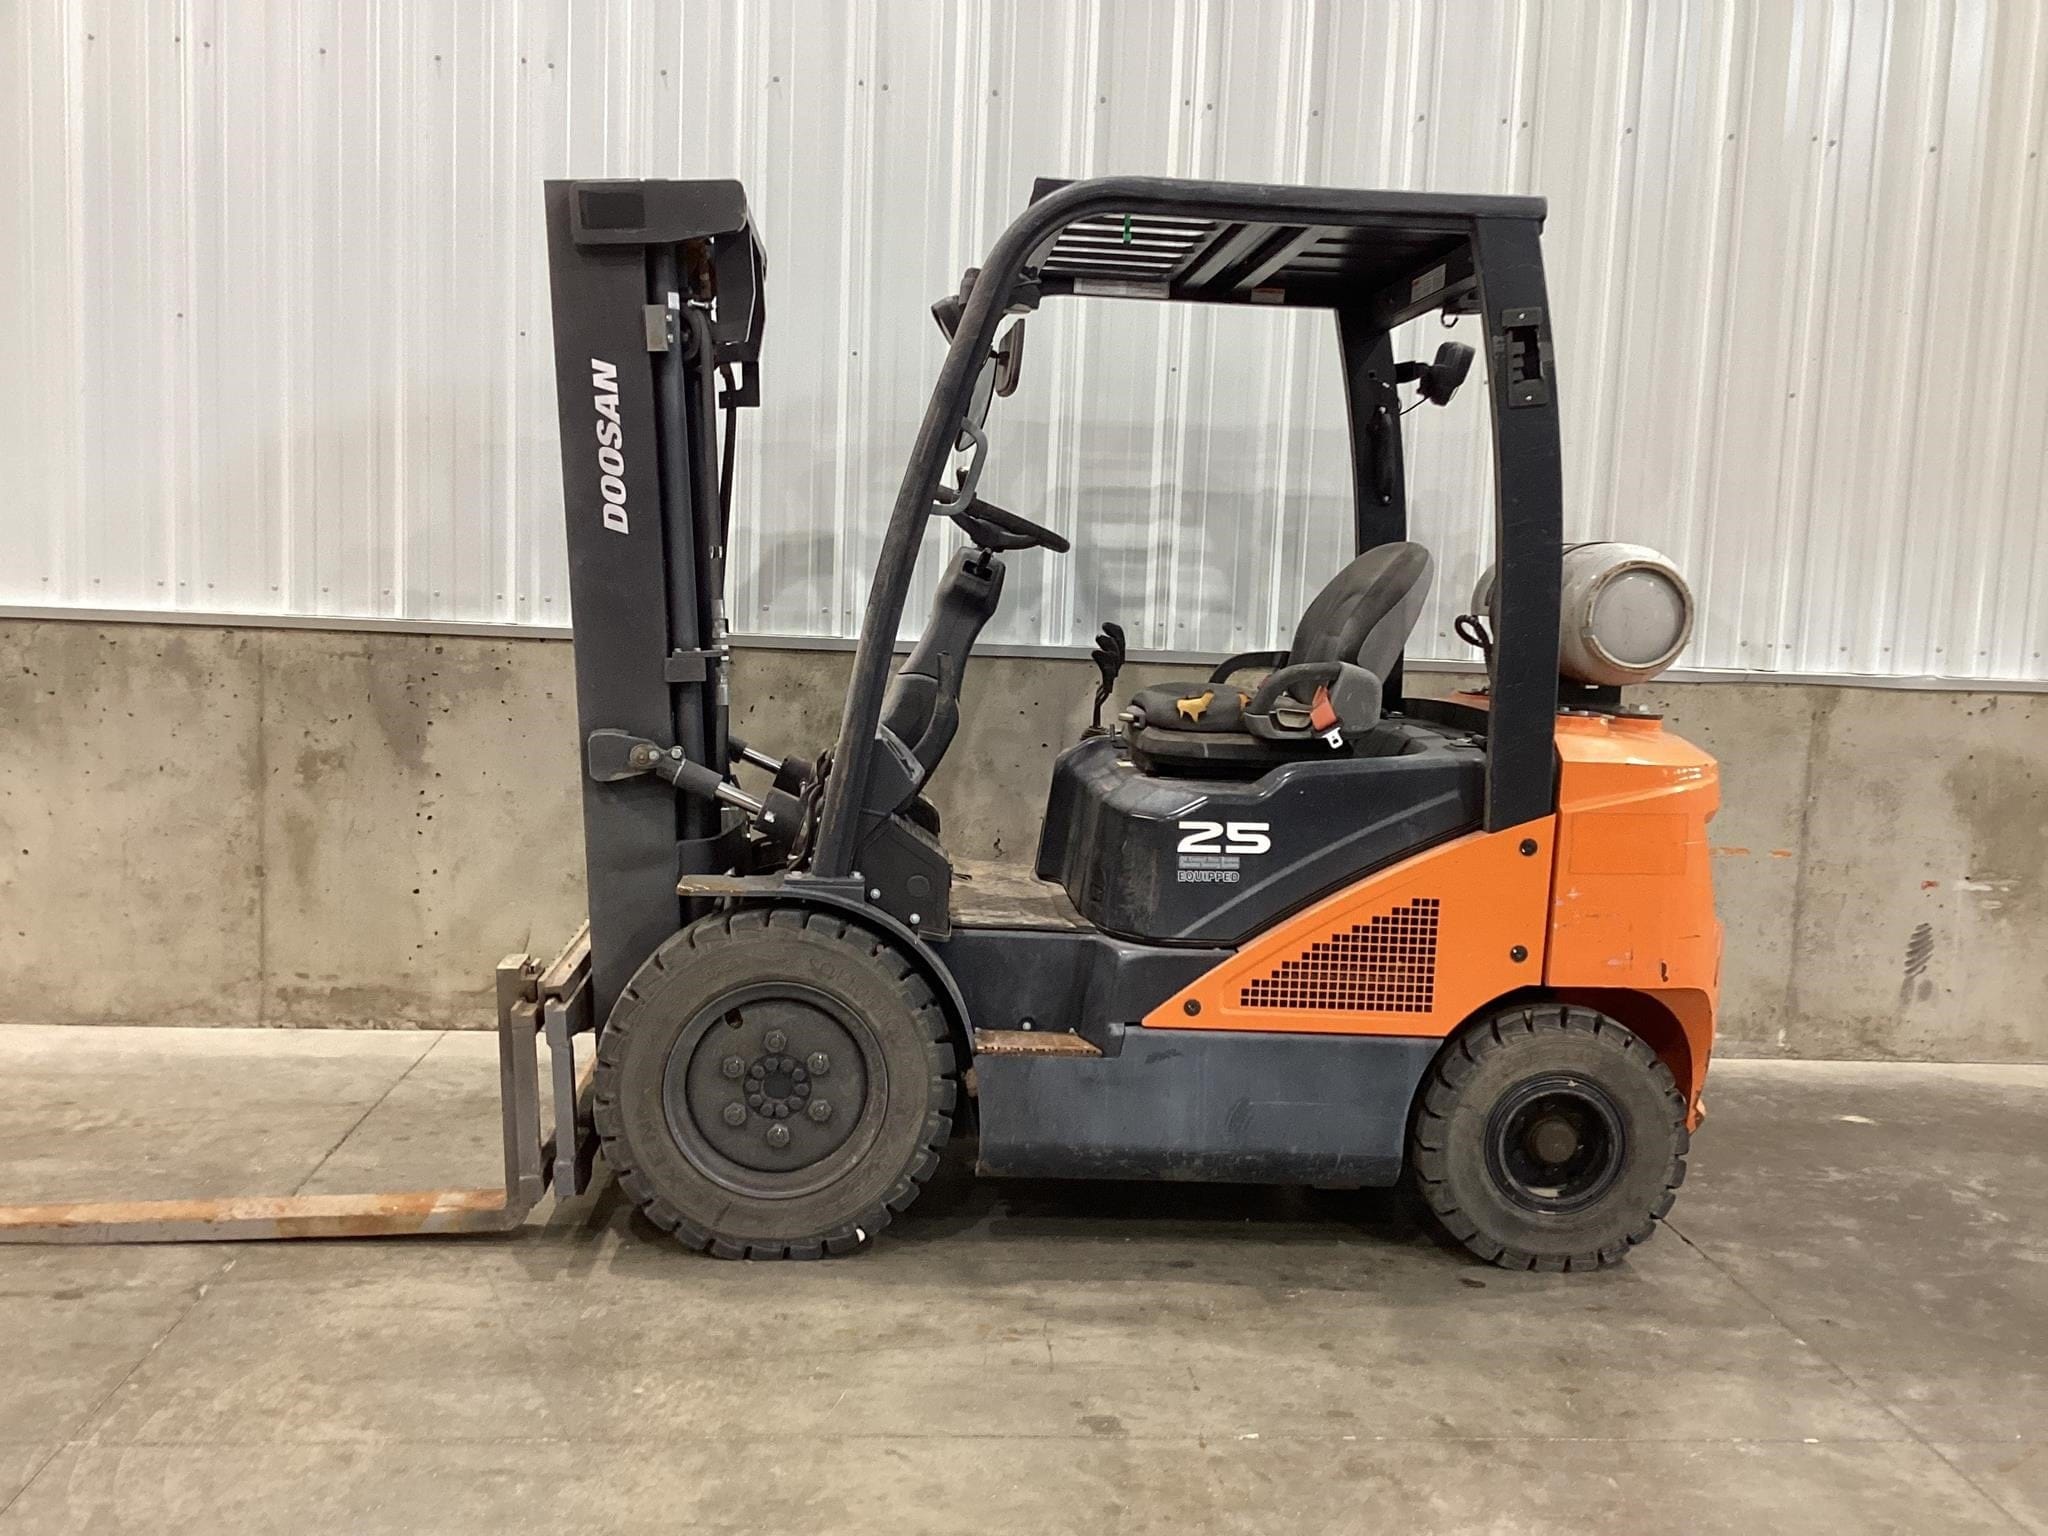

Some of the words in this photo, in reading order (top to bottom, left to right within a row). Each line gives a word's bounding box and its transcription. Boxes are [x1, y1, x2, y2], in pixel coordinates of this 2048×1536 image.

[591, 358, 629, 535] DOOSAN
[1177, 821, 1271, 855] 25
[1177, 870, 1240, 882] EQUIPPED
